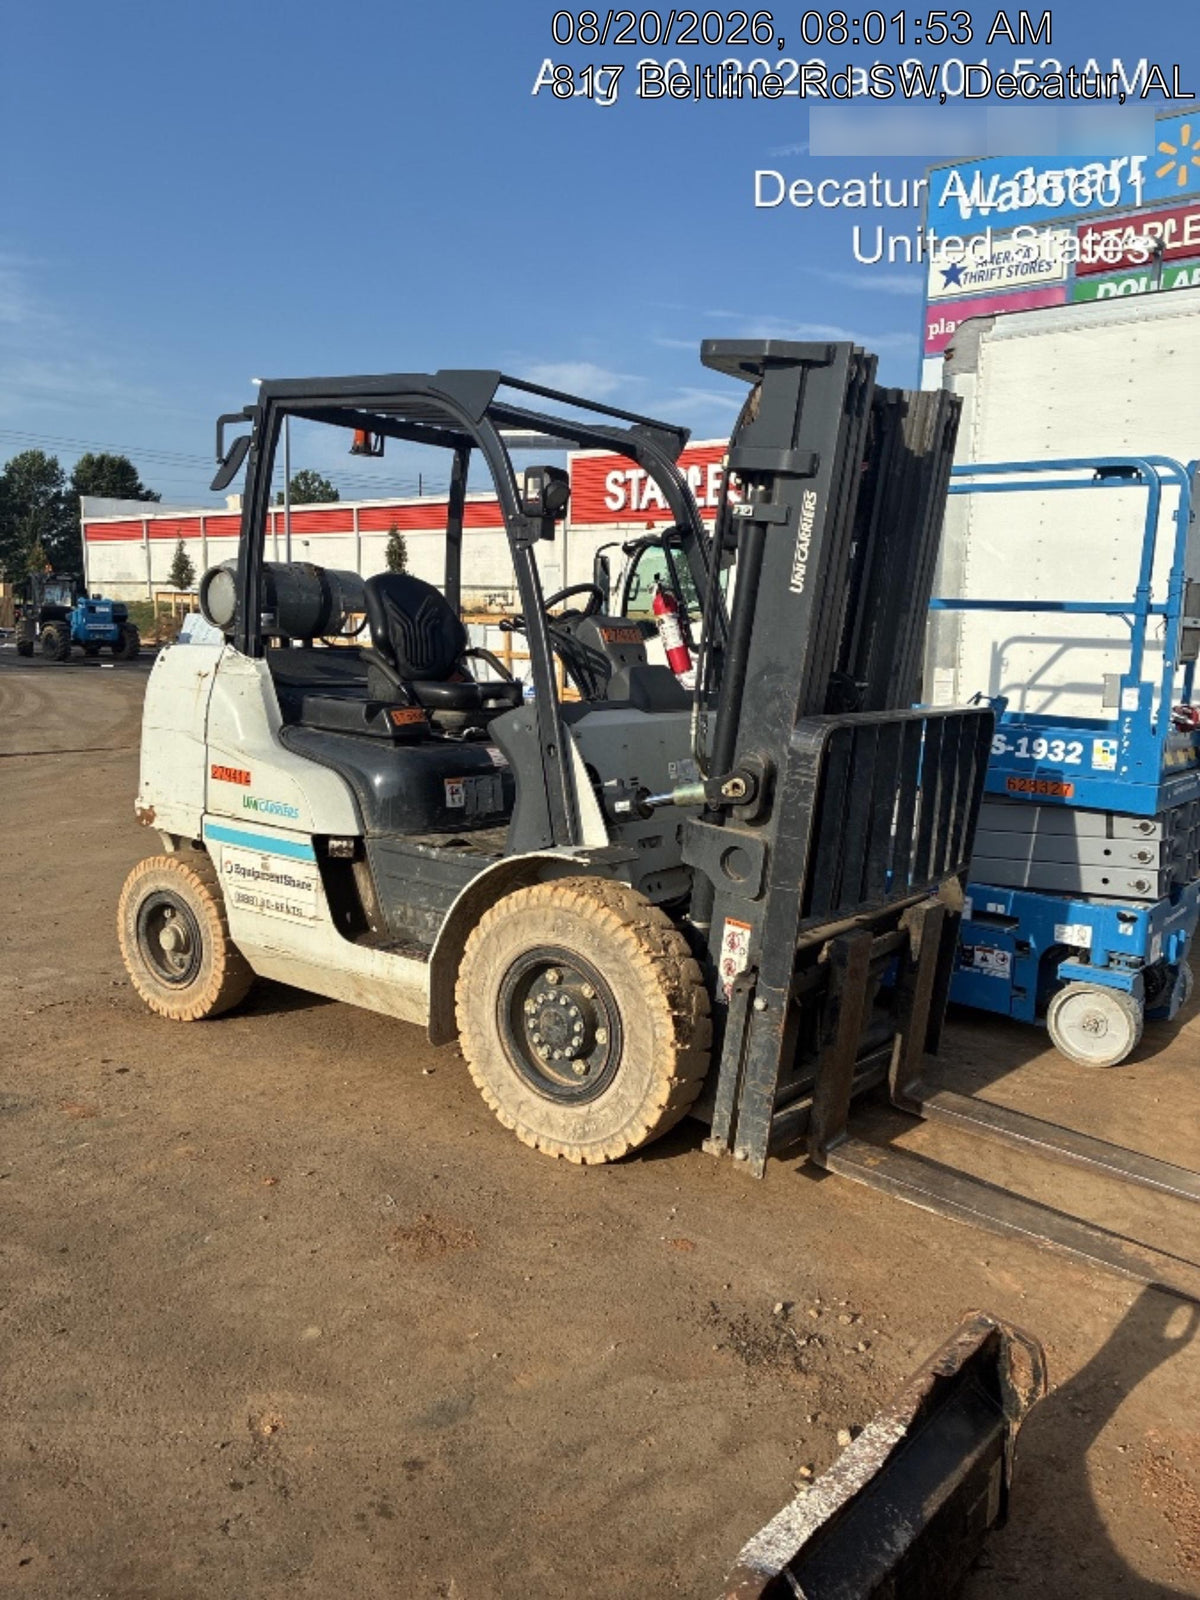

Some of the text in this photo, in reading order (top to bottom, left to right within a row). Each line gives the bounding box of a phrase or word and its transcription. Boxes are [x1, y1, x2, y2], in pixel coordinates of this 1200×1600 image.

[963, 260, 1053, 285] THRIFT STORES
[927, 317, 963, 341] pla
